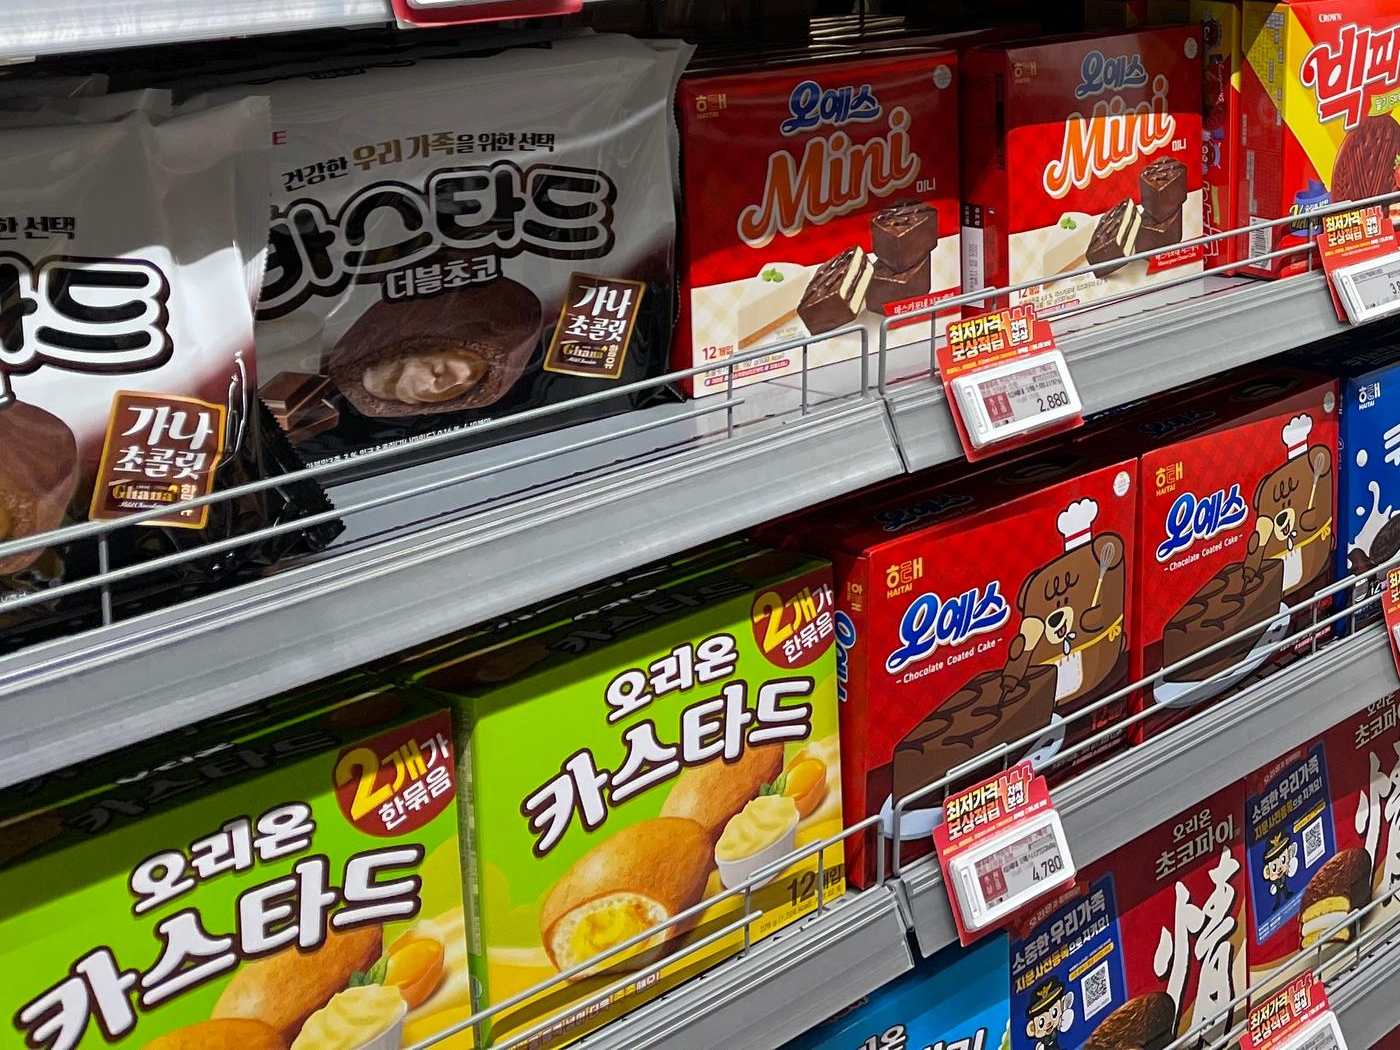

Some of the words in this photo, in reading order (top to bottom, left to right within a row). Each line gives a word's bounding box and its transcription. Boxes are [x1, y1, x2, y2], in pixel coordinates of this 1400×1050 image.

[1318, 13, 1342, 24] CROWN
[1075, 50, 1148, 99] 오예스
[781, 80, 881, 137] 오예스
[1043, 74, 1177, 199] Mini
[1172, 138, 1187, 152] 미니
[281, 156, 349, 192] 건강한
[353, 138, 403, 172] 우리
[405, 130, 475, 161] 가족을
[478, 132, 517, 153] 위한
[518, 132, 556, 153] 선택
[737, 106, 921, 249] Mini
[916, 178, 937, 194] 미니
[385, 253, 501, 301] 더블초코
[573, 283, 632, 320] 가나
[569, 315, 628, 343] 초콜릿
[949, 313, 1003, 343] 최저가격
[951, 332, 1005, 363] 보상적립
[121, 405, 213, 450] 가나
[1359, 401, 1375, 410] HAITAI
[113, 445, 208, 481] 초콜릿
[1156, 483, 1176, 497] HAITAI
[1156, 483, 1249, 562] 오예스
[1169, 551, 1200, 572] Chocolate
[1201, 540, 1223, 557] Coated
[1224, 534, 1239, 548] Cake
[887, 582, 913, 600] HAITAI
[752, 583, 834, 655] 2개가
[781, 610, 833, 663] 한묶음
[885, 580, 1011, 674] 오예스
[605, 633, 739, 726] 오리온
[903, 660, 944, 684] Chocolate
[948, 647, 975, 666] Coated
[977, 639, 997, 655] Cake
[333, 732, 450, 822] 2개가
[521, 676, 815, 859] 카스타드
[377, 763, 452, 831] 한묶음
[946, 781, 1000, 823] 최저가격
[1154, 816, 1235, 882] 초코파이
[1172, 808, 1213, 844] 오리온
[129, 802, 315, 917] 오리온
[14, 844, 426, 1050] 카스타드
[1011, 931, 1051, 976] 소중한
[1050, 889, 1106, 945] 우리가족
[1250, 989, 1292, 1030] 최저가격
